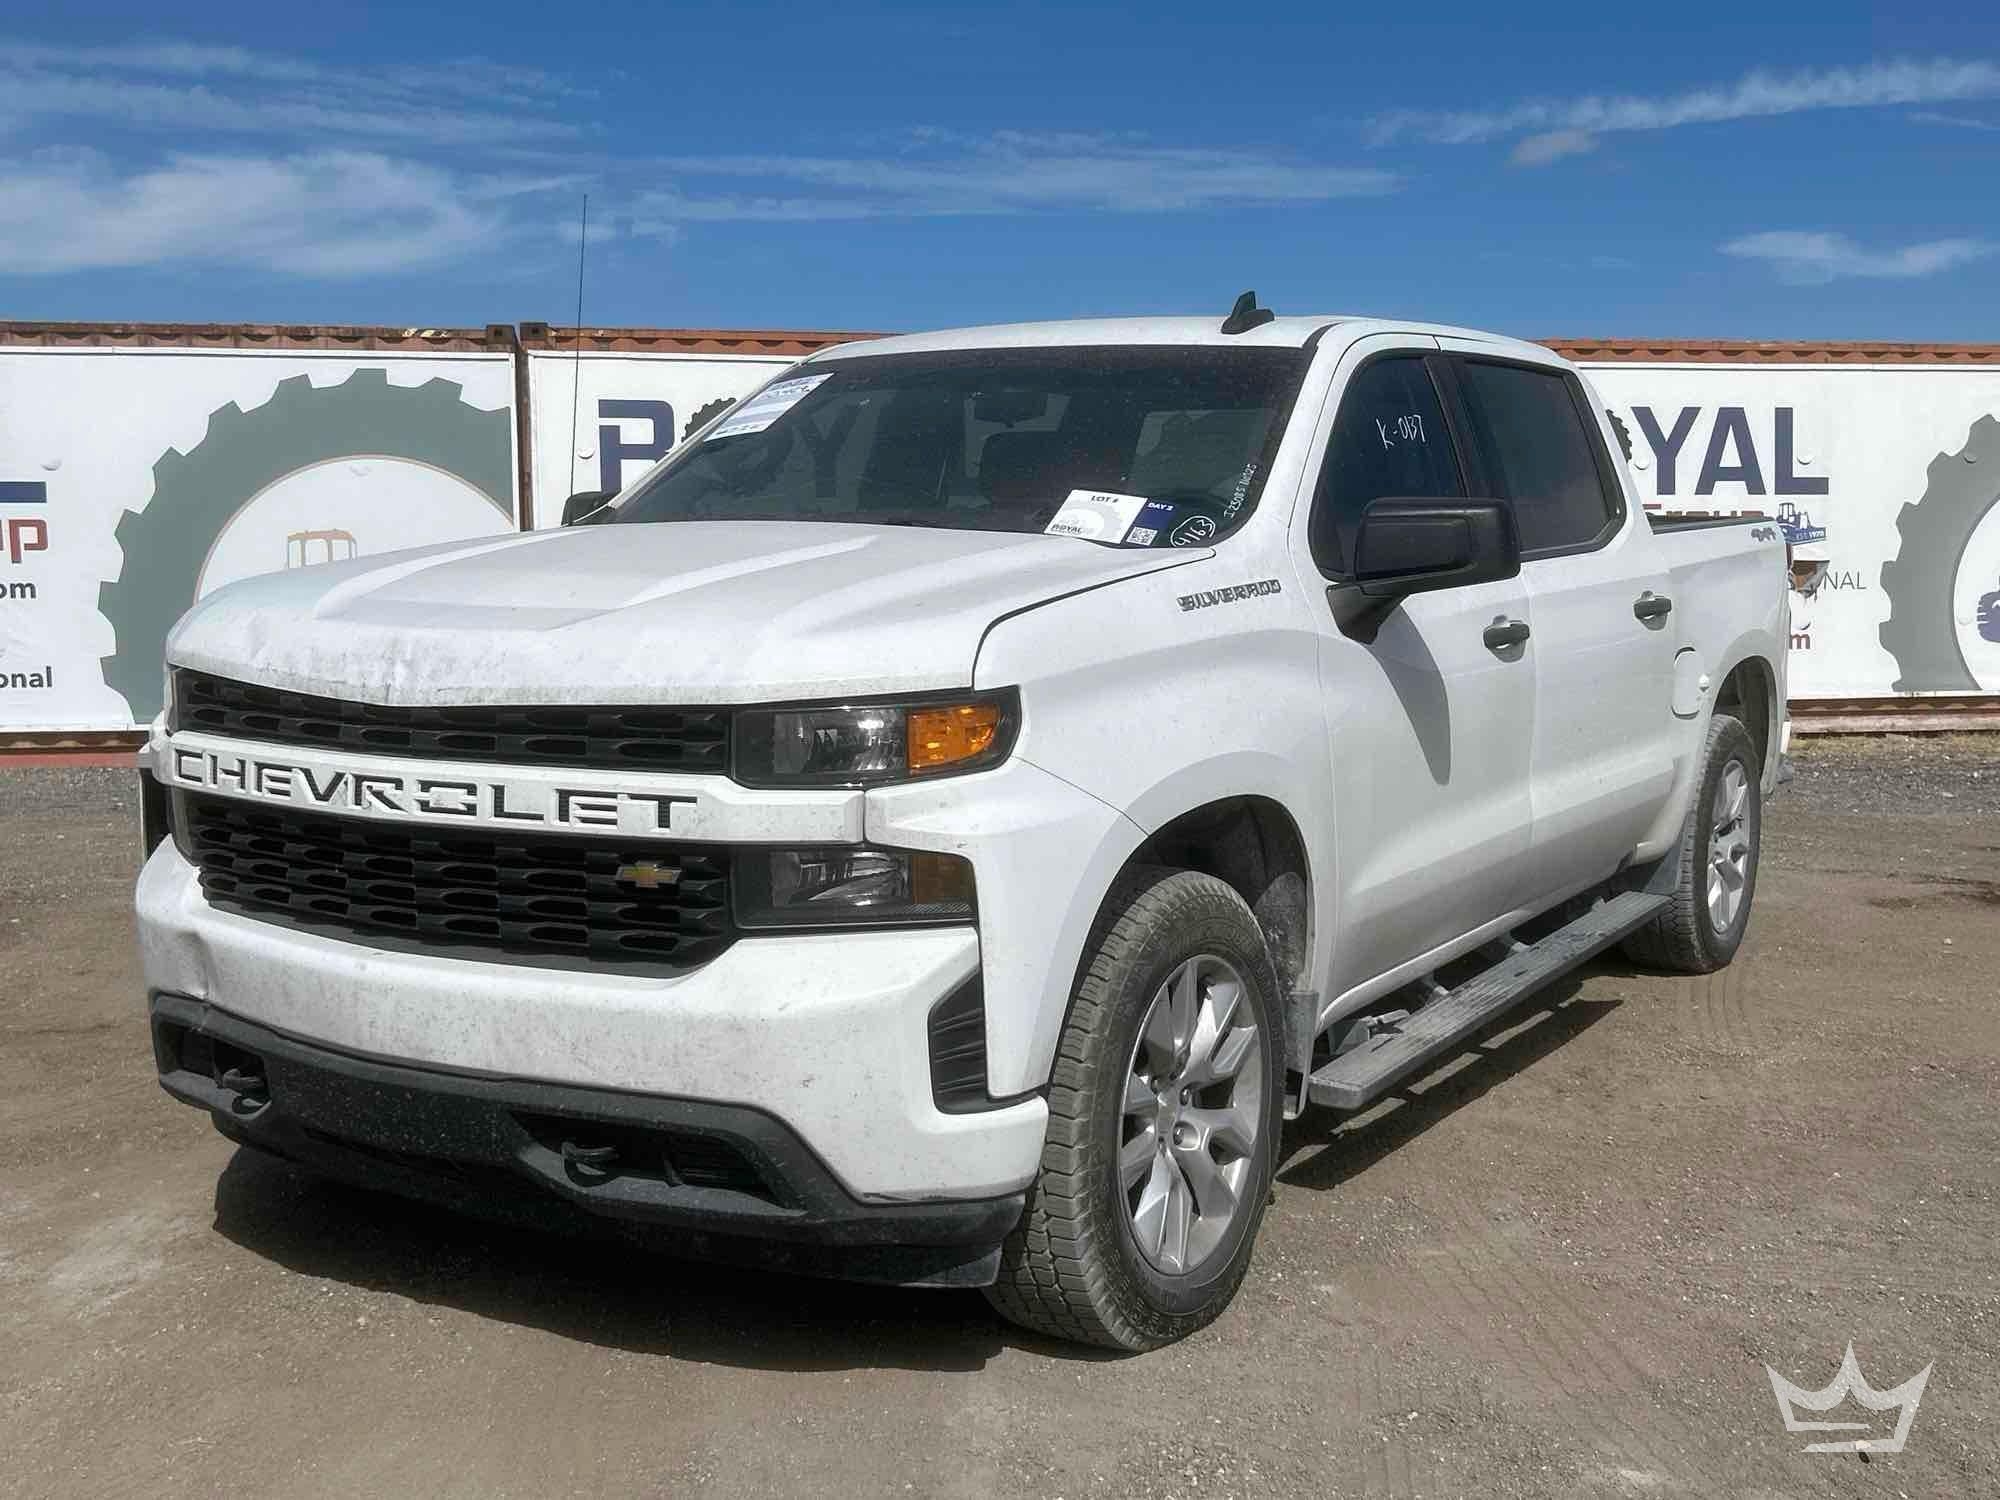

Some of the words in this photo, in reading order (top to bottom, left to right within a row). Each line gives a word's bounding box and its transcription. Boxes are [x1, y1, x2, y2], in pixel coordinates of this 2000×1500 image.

[1090, 495, 1112, 503] LOT
[1147, 502, 1167, 510] DAY
[1176, 578, 1282, 612] SILVERADO
[174, 748, 698, 834] CHEVROLET
